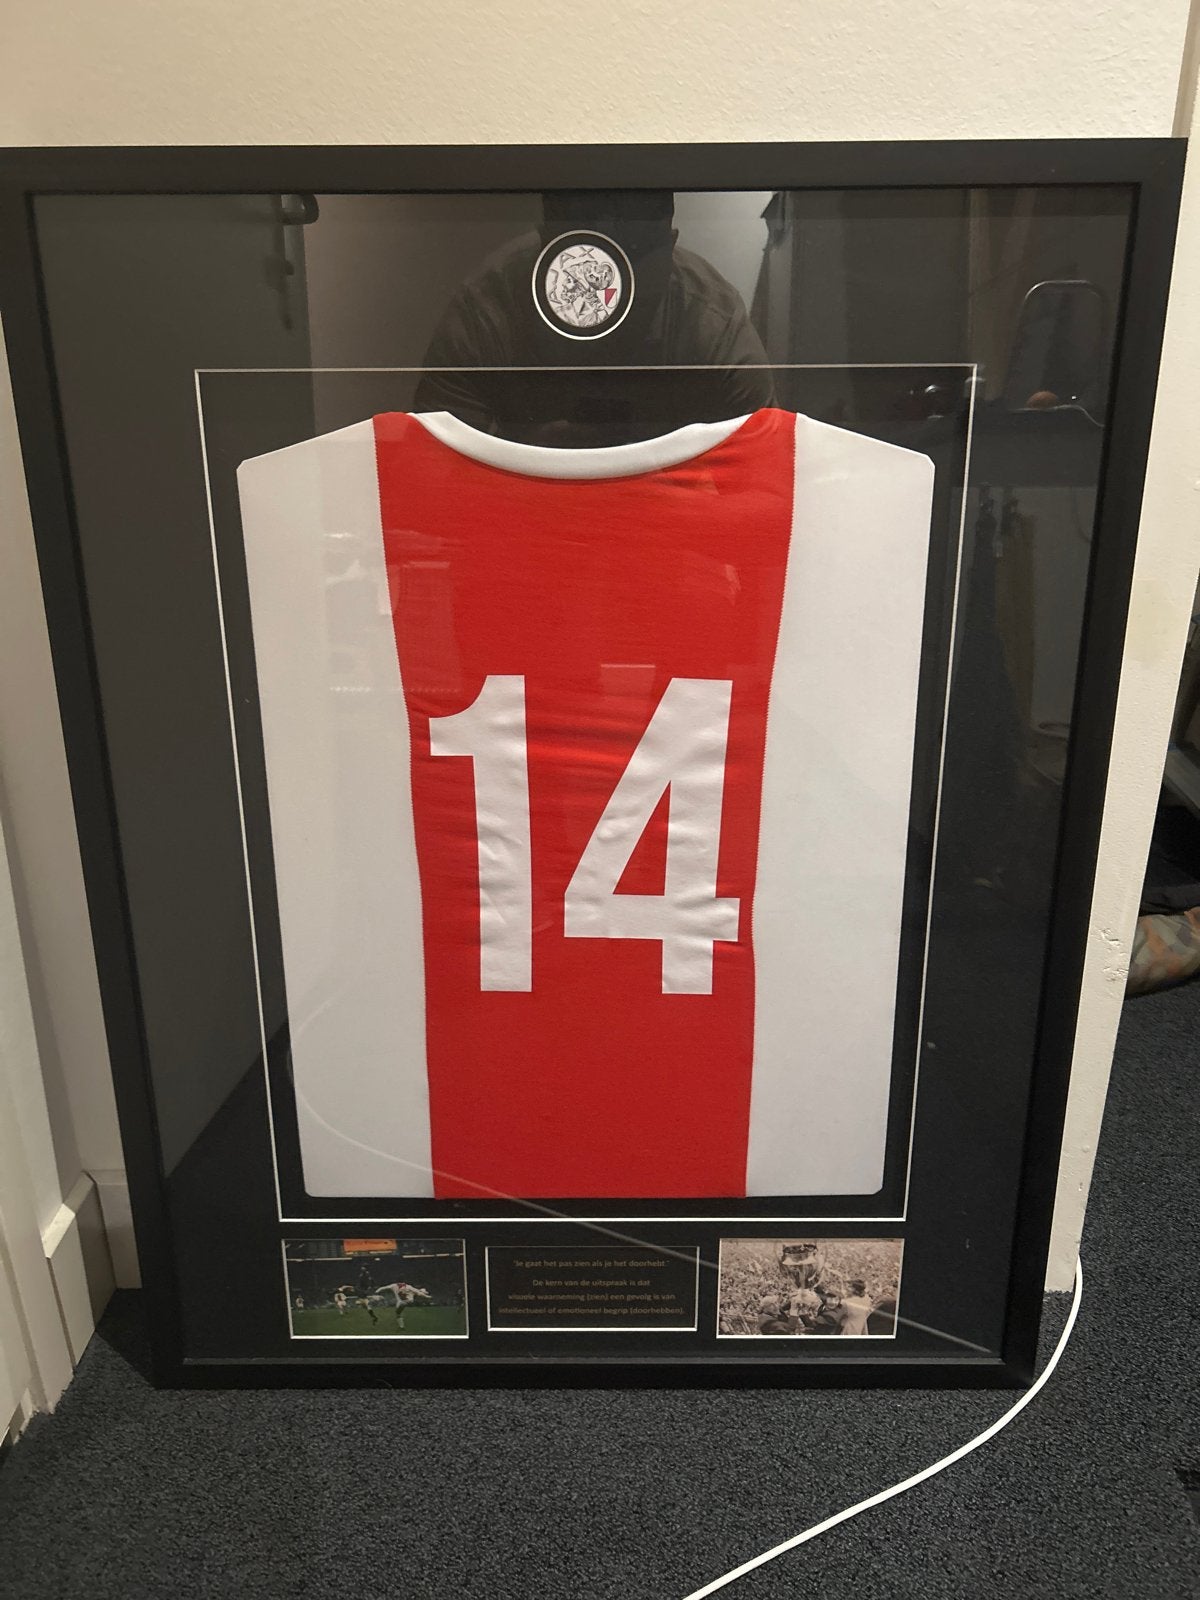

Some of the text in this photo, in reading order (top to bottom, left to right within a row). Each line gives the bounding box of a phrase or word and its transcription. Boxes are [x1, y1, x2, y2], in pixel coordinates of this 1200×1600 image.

[549, 246, 595, 305] AJAX
[429, 674, 740, 995] 14
[525, 1260, 542, 1268] gaat
[544, 1259, 557, 1267] het
[558, 1260, 572, 1268] pas
[574, 1259, 591, 1267] zien
[592, 1259, 602, 1267] als
[604, 1259, 612, 1269] je
[614, 1259, 627, 1267] het
[532, 1279, 544, 1287] De
[545, 1279, 562, 1287] kern
[580, 1279, 590, 1287] de
[592, 1279, 628, 1288] uitspraak
[630, 1279, 636, 1287] is
[637, 1279, 650, 1287] dat
[626, 1293, 652, 1302] gevolg
[653, 1293, 660, 1301] is
[603, 1307, 628, 1315] begrip
